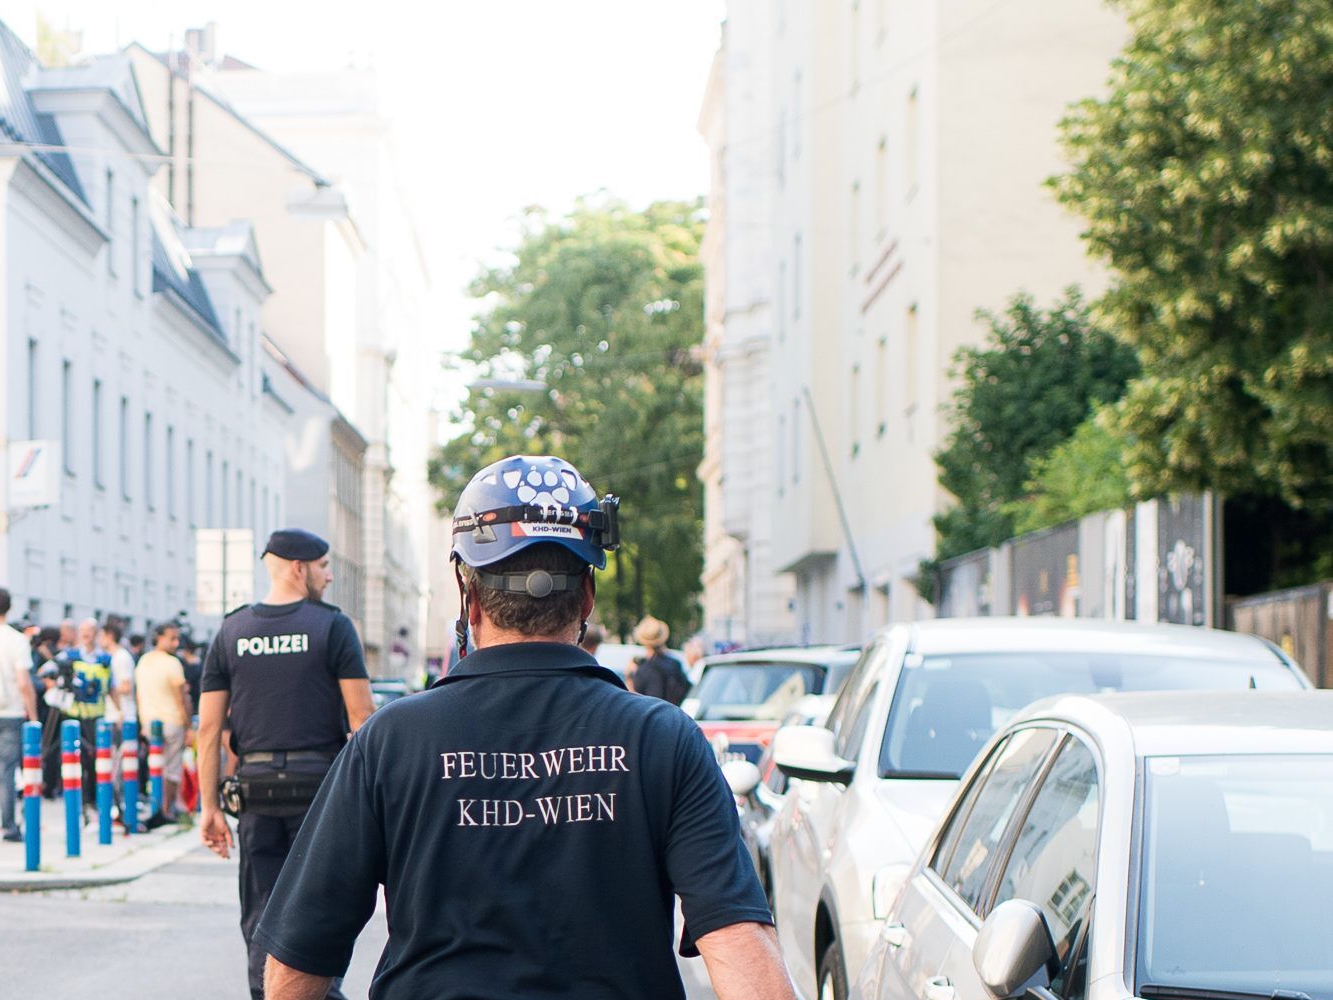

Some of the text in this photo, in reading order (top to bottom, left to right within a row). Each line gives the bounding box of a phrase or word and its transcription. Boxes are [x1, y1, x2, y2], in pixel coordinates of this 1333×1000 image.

[532, 525, 572, 534] KHD-WIEN
[237, 634, 309, 657] POLIZEI
[440, 745, 630, 780] FEUERWEHR
[456, 793, 617, 827] KHD-WIEN
